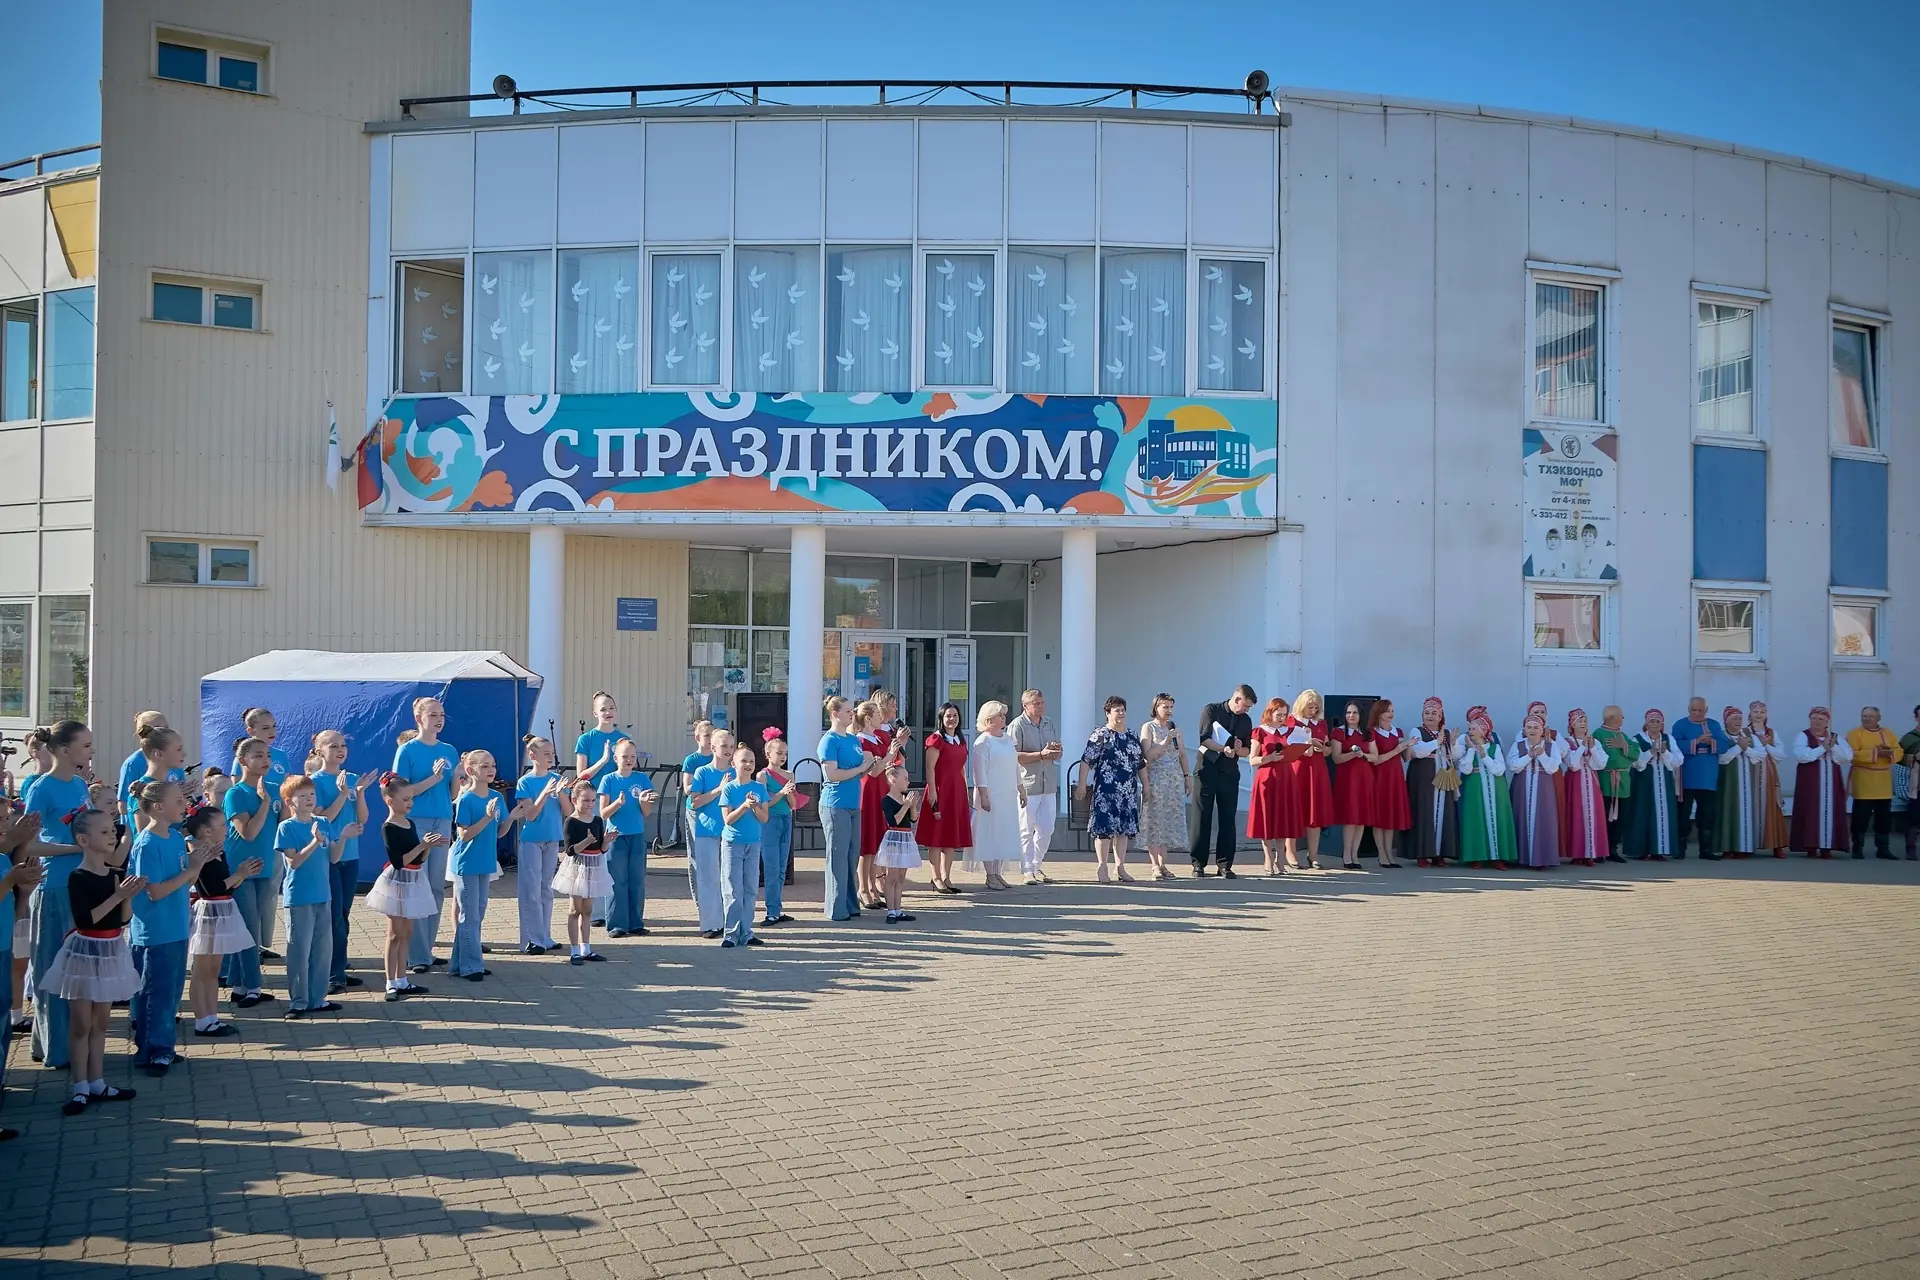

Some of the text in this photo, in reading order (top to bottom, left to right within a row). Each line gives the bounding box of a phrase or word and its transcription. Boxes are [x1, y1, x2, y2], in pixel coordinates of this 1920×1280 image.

[543, 427, 1103, 492] С ПРАЗДНИКОМ!
[1538, 465, 1603, 478] ТХЭКВОНДО
[1560, 477, 1583, 487] МФТ
[1562, 496, 1576, 504] 4-х
[1539, 511, 1567, 519] 333-412
